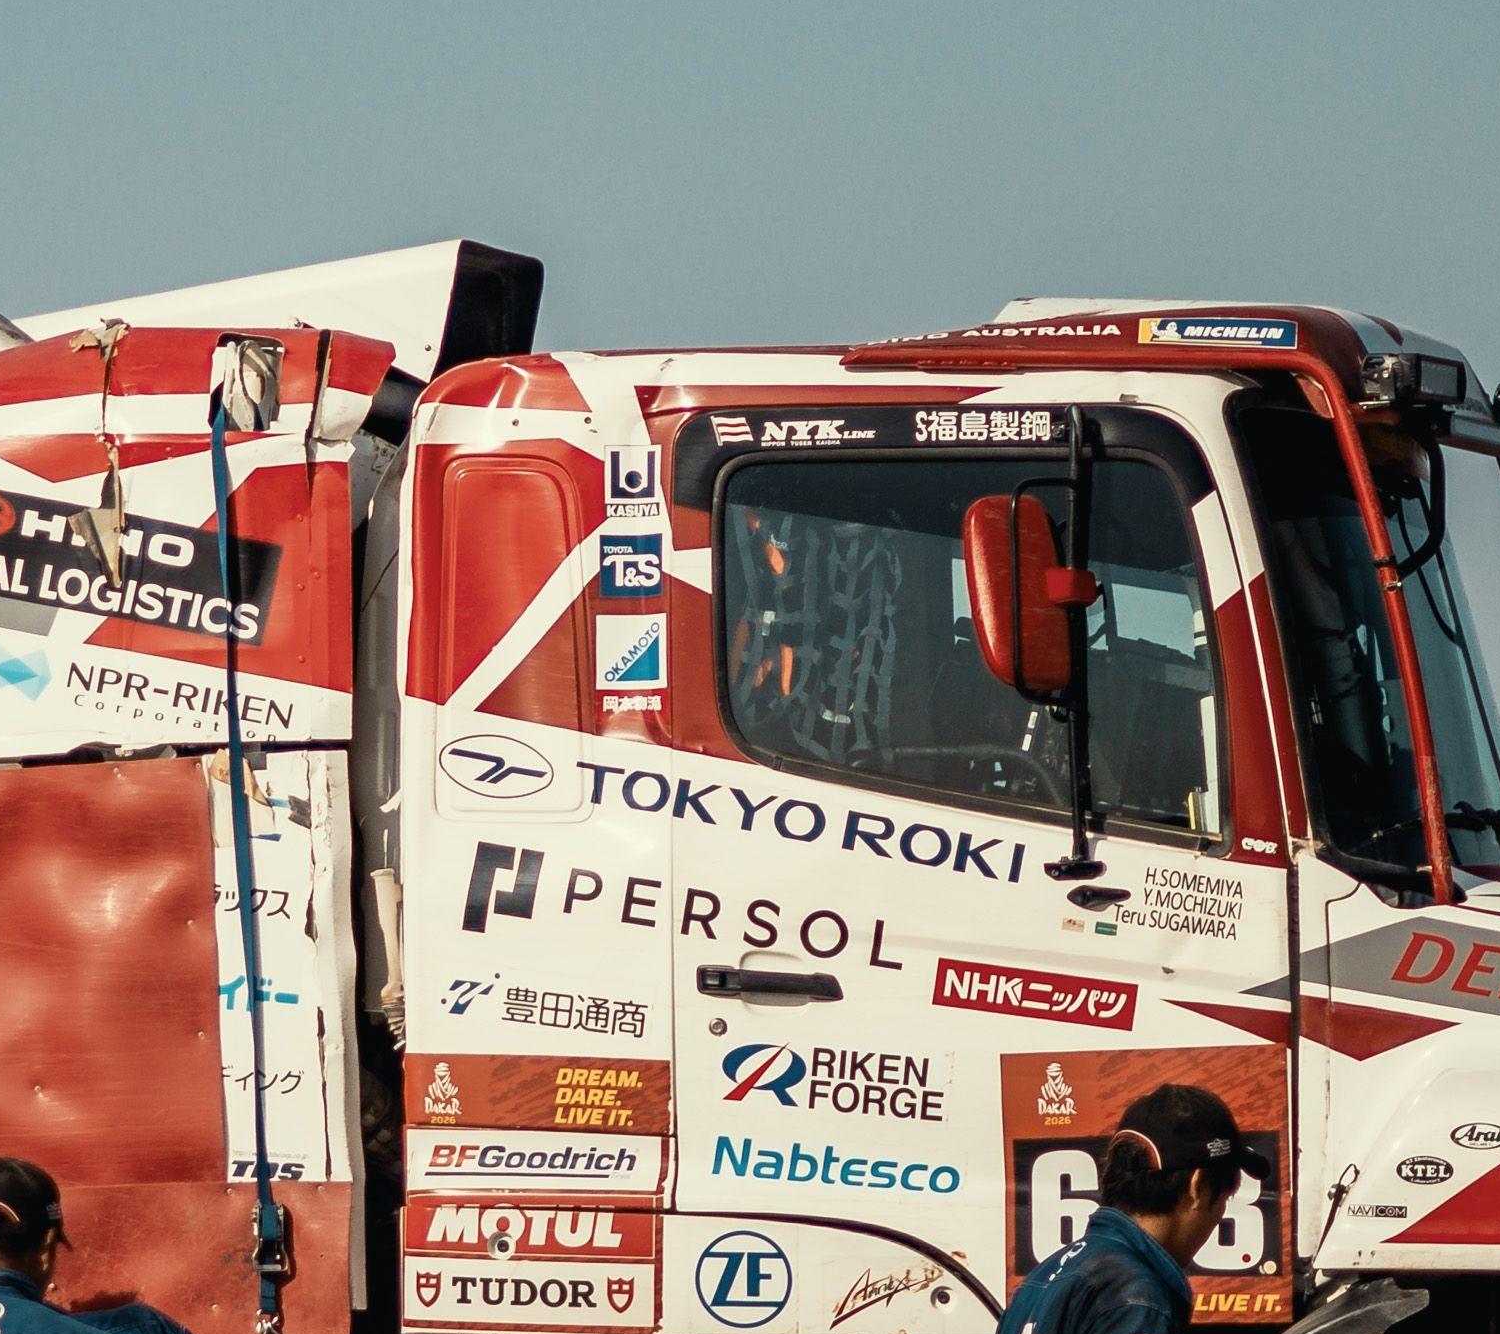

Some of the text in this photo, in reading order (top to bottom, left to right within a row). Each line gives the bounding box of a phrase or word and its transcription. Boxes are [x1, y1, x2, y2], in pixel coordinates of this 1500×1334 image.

[961, 324, 1122, 339] AUSTRALIA
[1183, 325, 1285, 340] MICHELIN
[760, 419, 876, 442] NYK LINE
[606, 503, 661, 517] KASUYA
[602, 545, 634, 554] TOYOTA
[602, 553, 661, 587] T&S
[38, 566, 262, 639] LOGISTICS
[604, 620, 661, 683] OKAMOTO
[65, 660, 295, 730] NPR-RIKEN
[73, 693, 279, 743] Corporaton
[576, 760, 1027, 885] TOKYO ROKI
[1144, 867, 1244, 901] H.SOMEMIYA
[562, 867, 904, 971] PERSOL
[1143, 887, 1243, 921] Y.MOCHIZUKI
[1113, 903, 1238, 942] Teru SUGAWARA
[501, 986, 649, 1039] 豊田通商
[554, 1067, 643, 1088] DREAM.
[810, 1046, 930, 1088] RIKEN
[424, 1096, 463, 1116] DAKAR
[555, 1087, 622, 1107] DARE.
[807, 1079, 945, 1122] FORGE
[1038, 1096, 1077, 1116] DAKAR
[430, 1116, 457, 1125] 2026
[554, 1108, 635, 1127] LIVE IT.
[1044, 1116, 1073, 1126] 2026
[428, 1144, 638, 1172] BFGoodrich
[711, 1135, 961, 1195] Nabtesco
[1401, 1164, 1450, 1178] KTEL
[426, 1203, 625, 1249] MOTUL
[1347, 1205, 1408, 1218] NAVICOM
[451, 1275, 598, 1308] TUDOR
[703, 1251, 786, 1308] ZF
[1195, 1293, 1283, 1313] LIVE IT.
